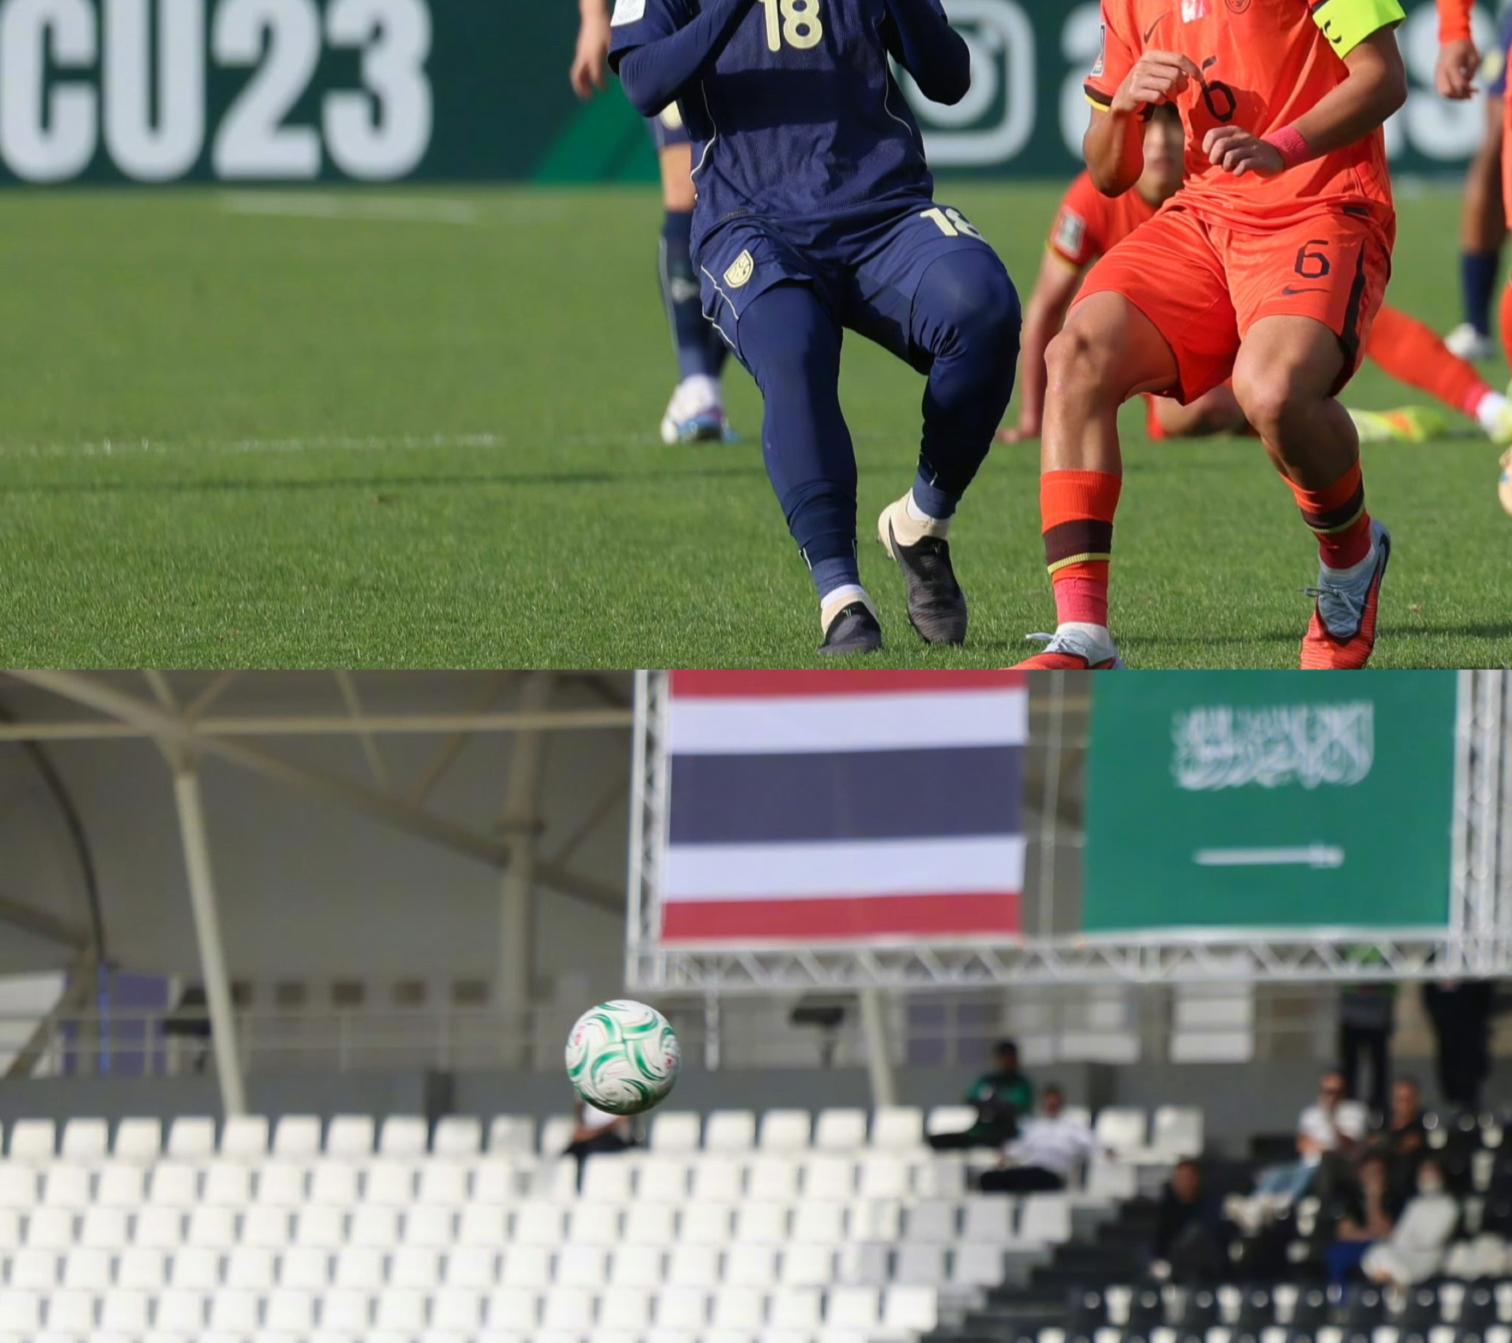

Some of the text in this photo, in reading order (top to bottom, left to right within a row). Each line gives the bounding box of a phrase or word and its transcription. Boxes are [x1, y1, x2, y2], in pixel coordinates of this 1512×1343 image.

[1200, 55, 1237, 123] 6
[920, 207, 988, 244] 18
[1294, 239, 1330, 278] 6
